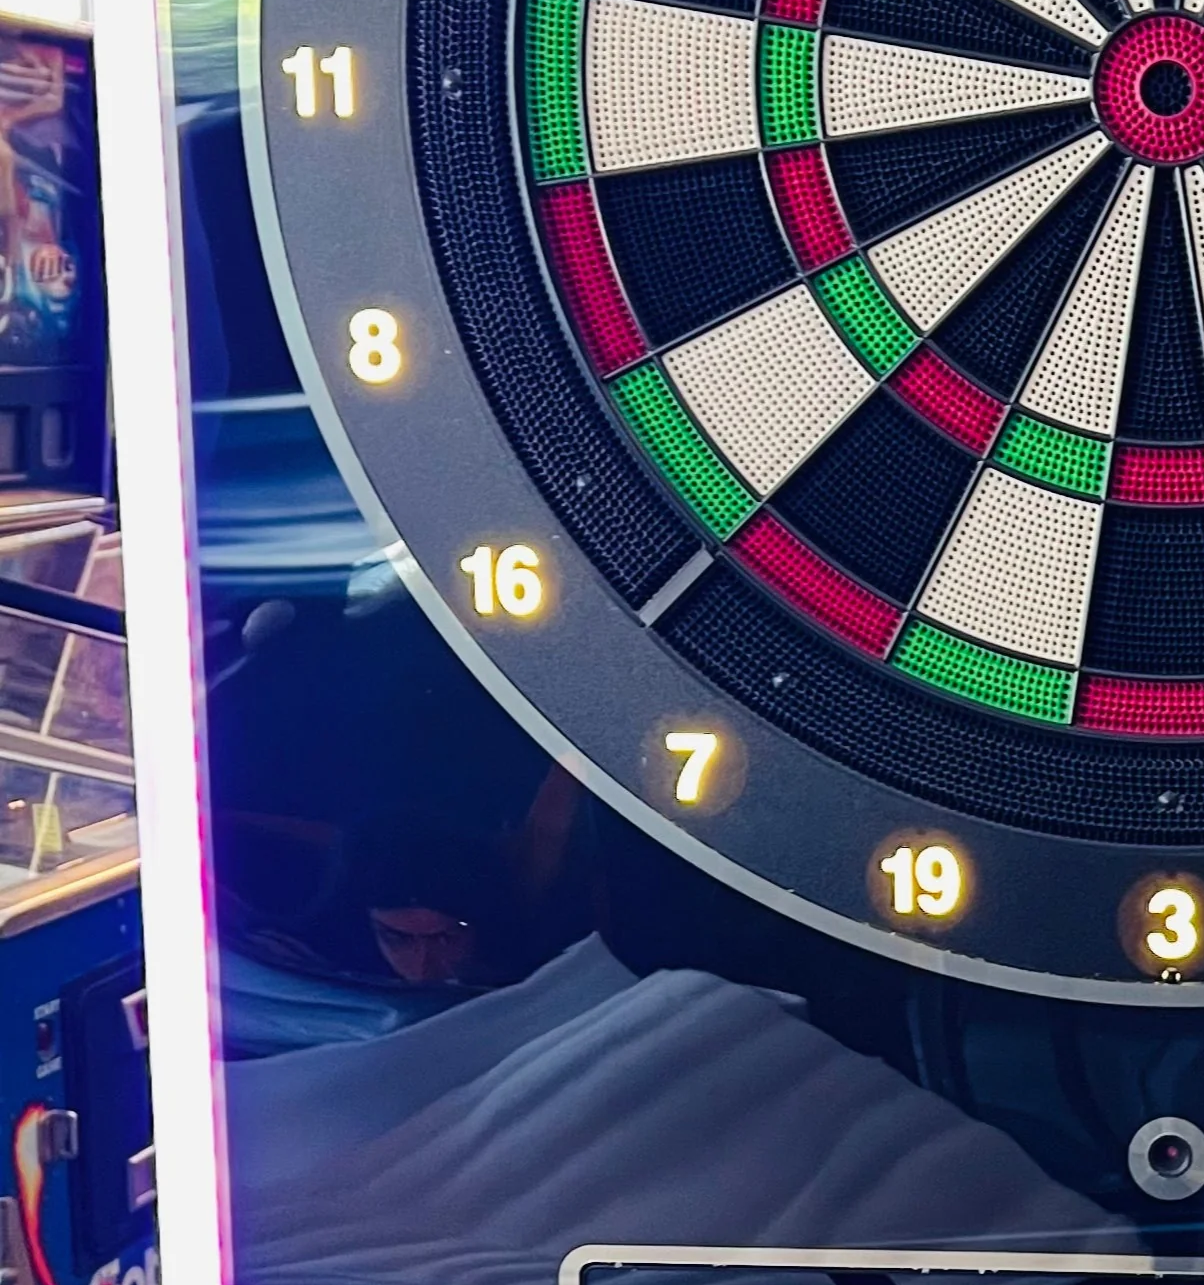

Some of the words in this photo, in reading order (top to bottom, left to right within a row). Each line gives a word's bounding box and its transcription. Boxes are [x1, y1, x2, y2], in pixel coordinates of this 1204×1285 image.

[280, 45, 355, 119] 11
[348, 307, 403, 385] 8
[459, 543, 545, 617] 16
[664, 731, 719, 803] 7
[880, 845, 963, 917] 19
[1146, 887, 1199, 961] 3
